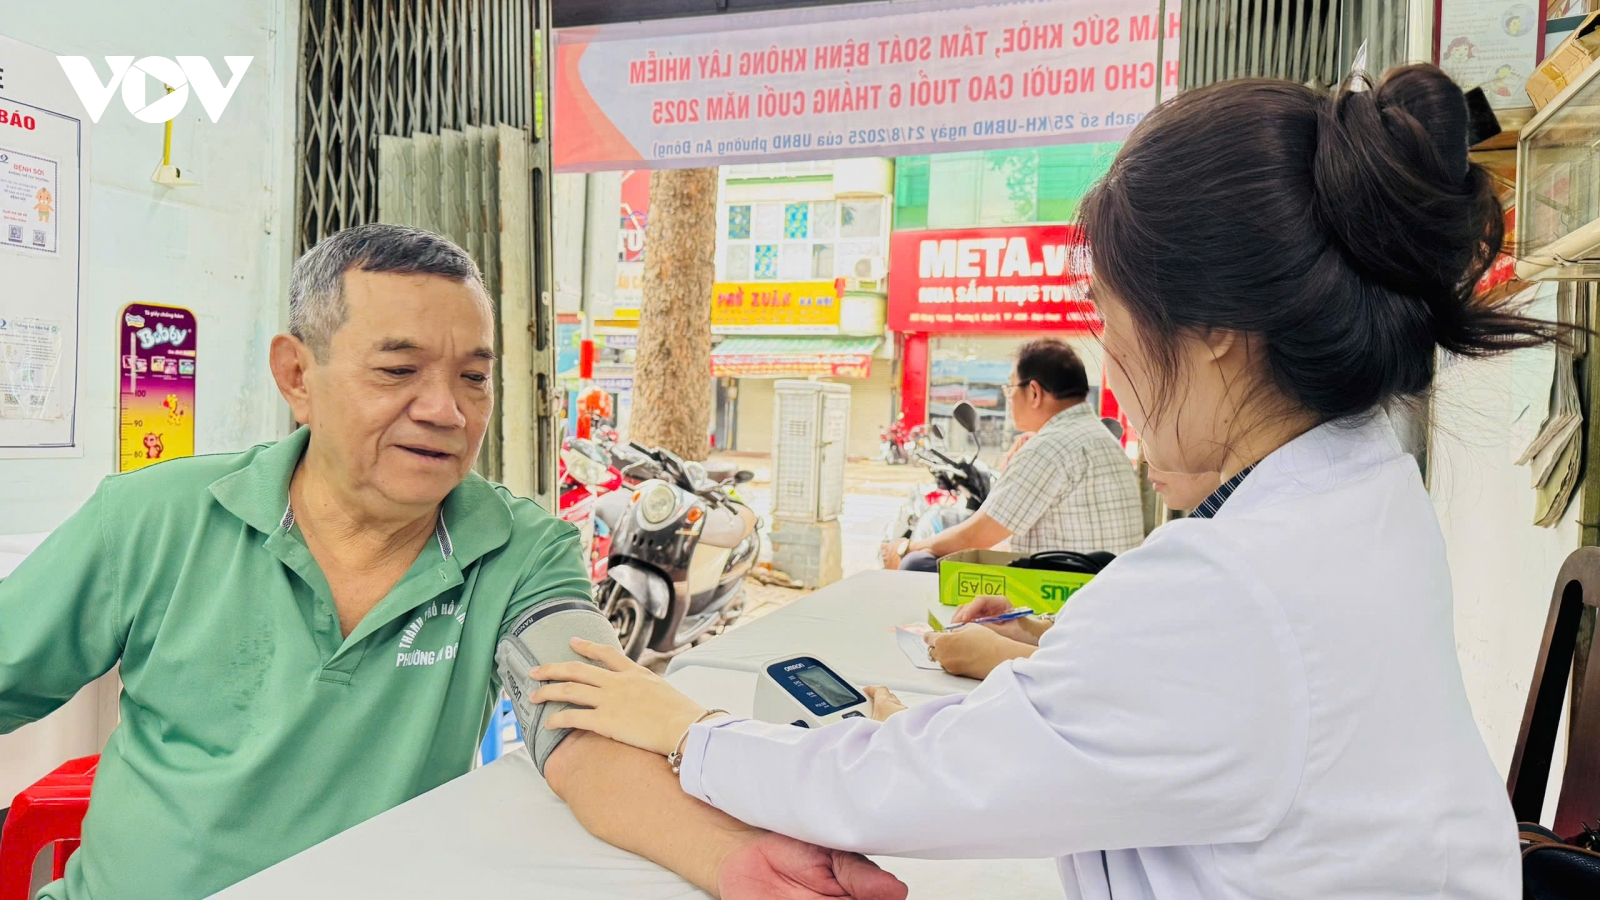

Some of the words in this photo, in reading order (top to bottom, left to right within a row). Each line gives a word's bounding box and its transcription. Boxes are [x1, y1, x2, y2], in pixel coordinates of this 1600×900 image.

[0, 109, 36, 131] BÁO
[919, 237, 1093, 278] META.v
[136, 322, 187, 349] Bobby
[960, 580, 979, 592] A5
[984, 582, 1003, 596] 70
[398, 617, 424, 649] THÀNH
[424, 600, 438, 621] PHỐ
[441, 600, 455, 615] HỒ
[396, 649, 436, 667] PHƯỜNG
